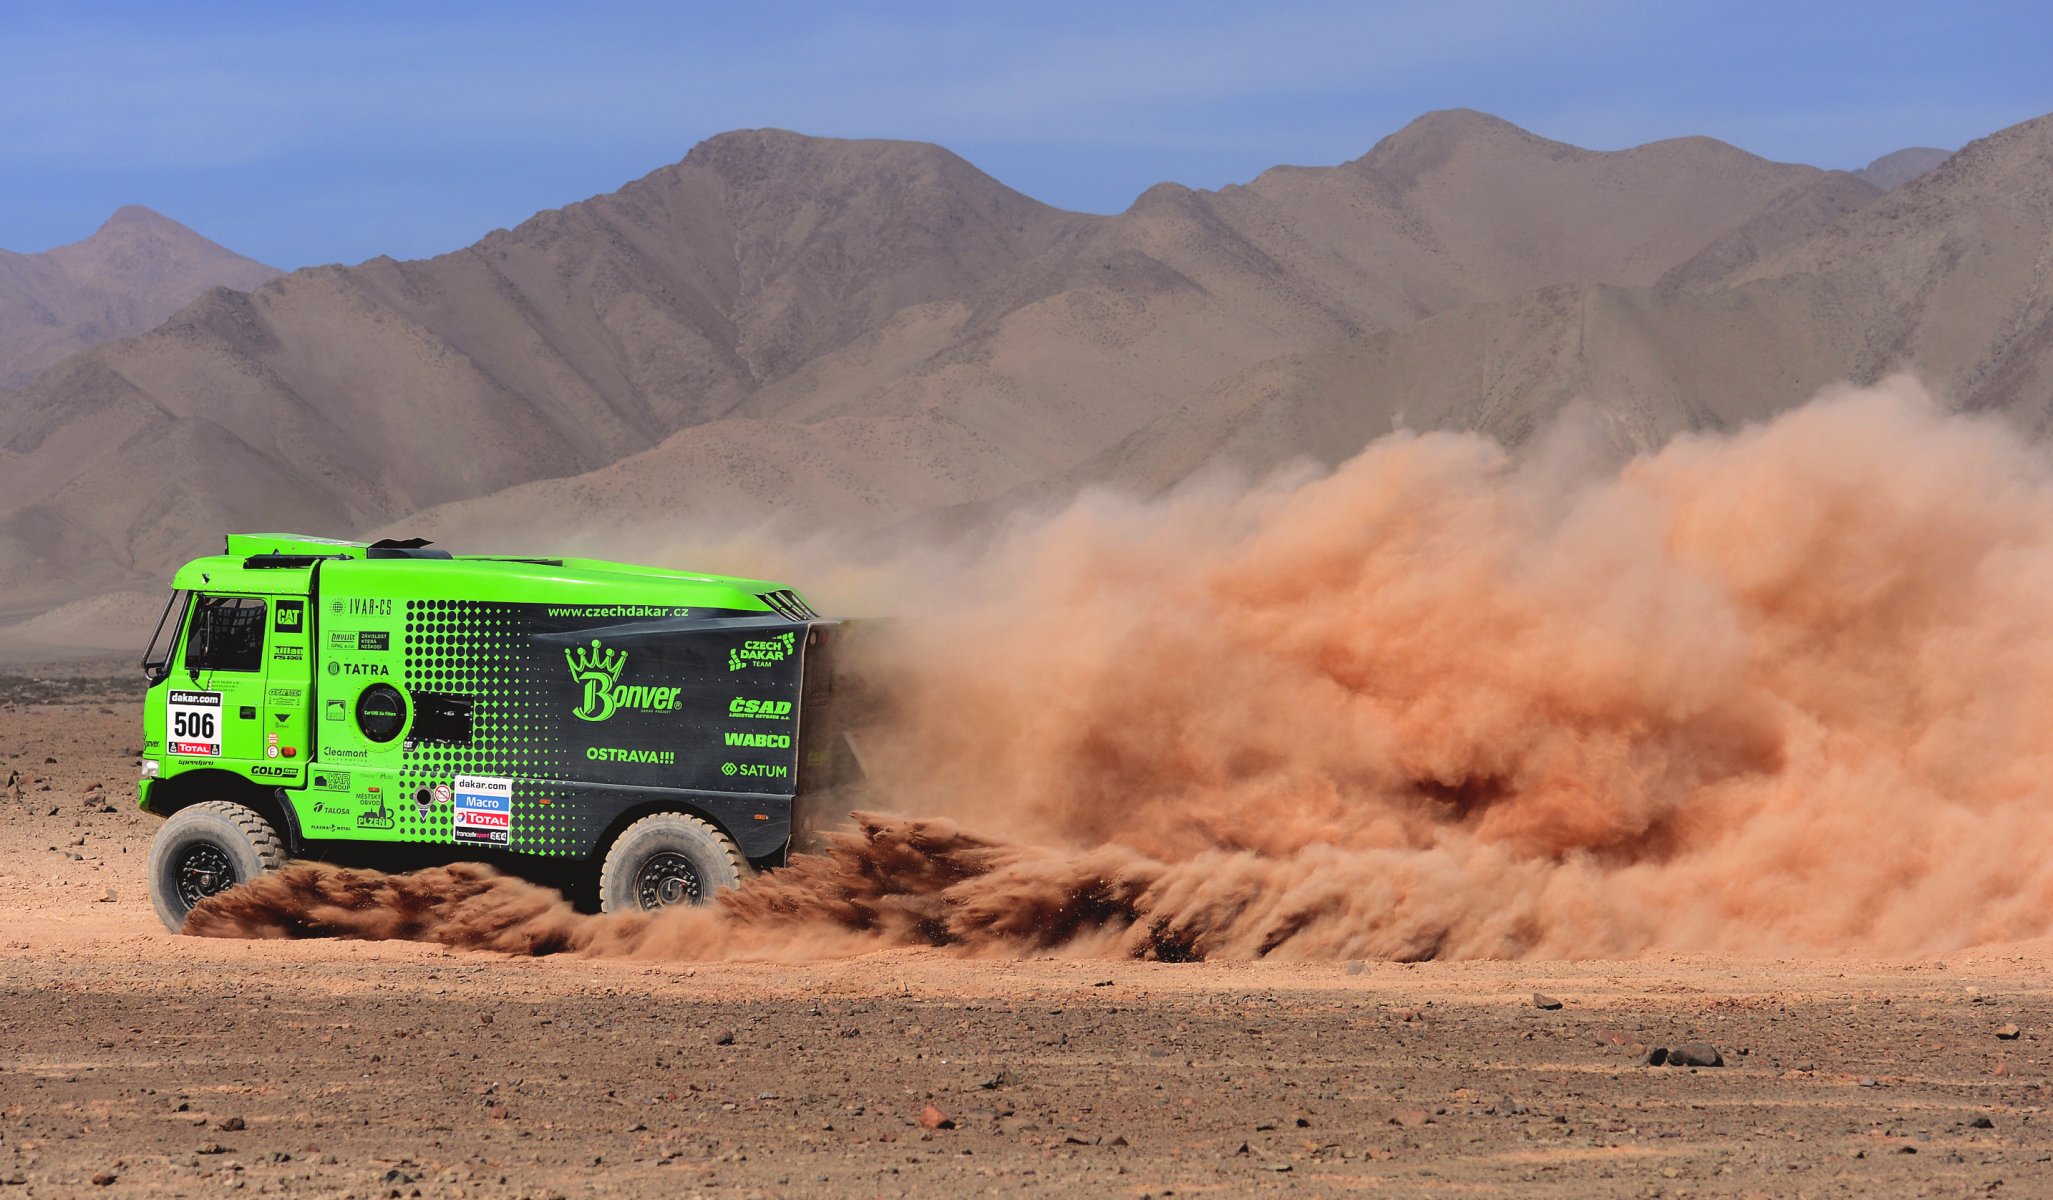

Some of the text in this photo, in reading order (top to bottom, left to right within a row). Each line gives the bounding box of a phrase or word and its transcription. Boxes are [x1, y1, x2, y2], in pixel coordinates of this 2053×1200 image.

[277, 609, 299, 625] CAT
[548, 606, 689, 618] www.czechdakar.cz
[744, 641, 781, 650] CZECH
[740, 650, 784, 661] DAKAR
[344, 663, 389, 675] TATRA
[172, 693, 218, 704] dakar.com
[729, 697, 792, 715] ČSAD
[174, 712, 214, 739] 506
[725, 732, 791, 749] WABCO
[180, 744, 209, 753] TOTAL
[324, 747, 368, 758] Clearmont
[586, 747, 675, 765] OSTRAVA!!!
[251, 765, 282, 775] GOLD
[740, 764, 787, 778] SATUM
[459, 779, 507, 790] dakar.com
[466, 796, 499, 808] Macro
[468, 813, 507, 825] TOTAL
